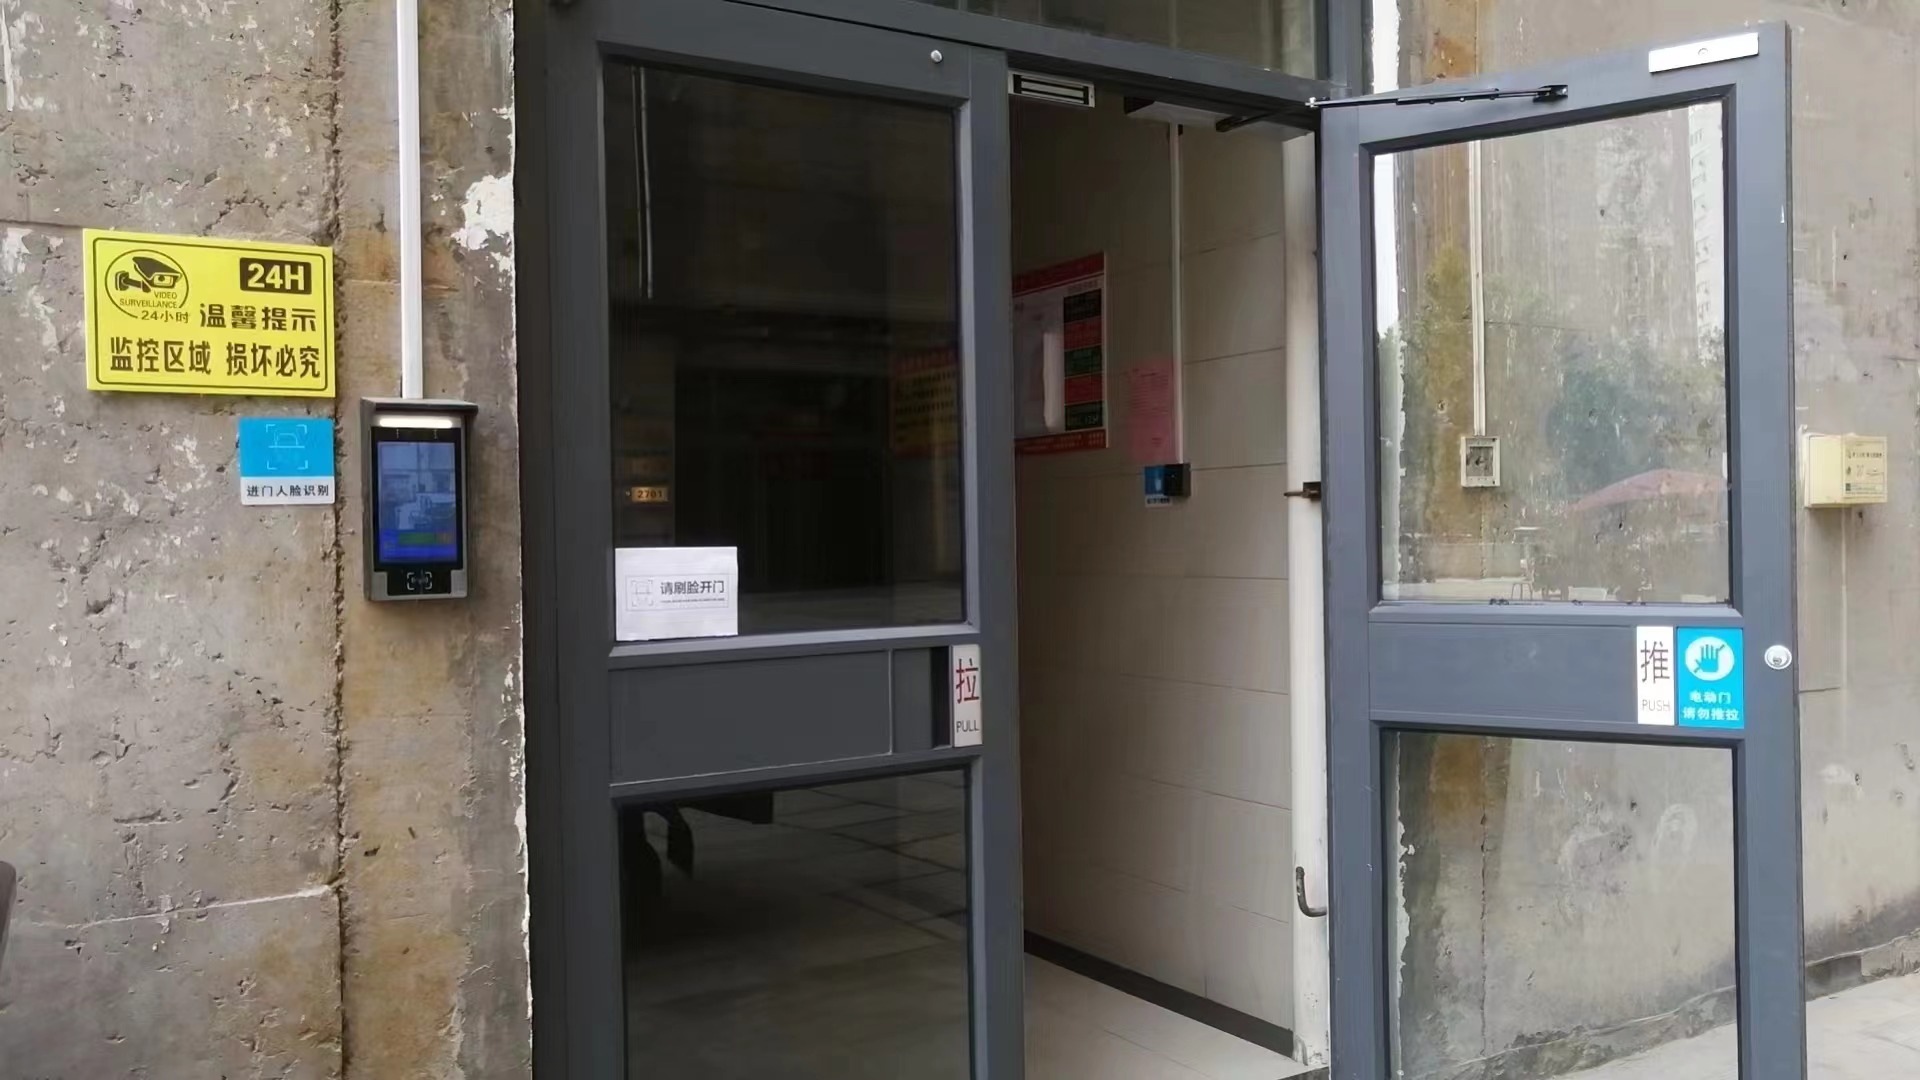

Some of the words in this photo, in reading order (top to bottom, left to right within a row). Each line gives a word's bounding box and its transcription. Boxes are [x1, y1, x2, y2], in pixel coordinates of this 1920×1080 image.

[248, 263, 305, 291] 24H
[153, 291, 177, 299] VIDEO
[119, 298, 178, 308] SURVEILLANCE
[141, 310, 189, 324] 24小时
[200, 303, 316, 332] 温馨提示
[110, 336, 211, 374] 监控区域
[226, 341, 320, 379] 损坏必究
[246, 484, 329, 497] 进门人脸识别
[660, 580, 725, 595] 请刷脸开门
[1640, 640, 1671, 684] 推
[956, 658, 980, 704] 拉
[1689, 690, 1732, 704] 电动门
[1642, 699, 1671, 712] PUSH
[1683, 707, 1740, 721] 请勿推拉
[956, 720, 979, 733] PULL
